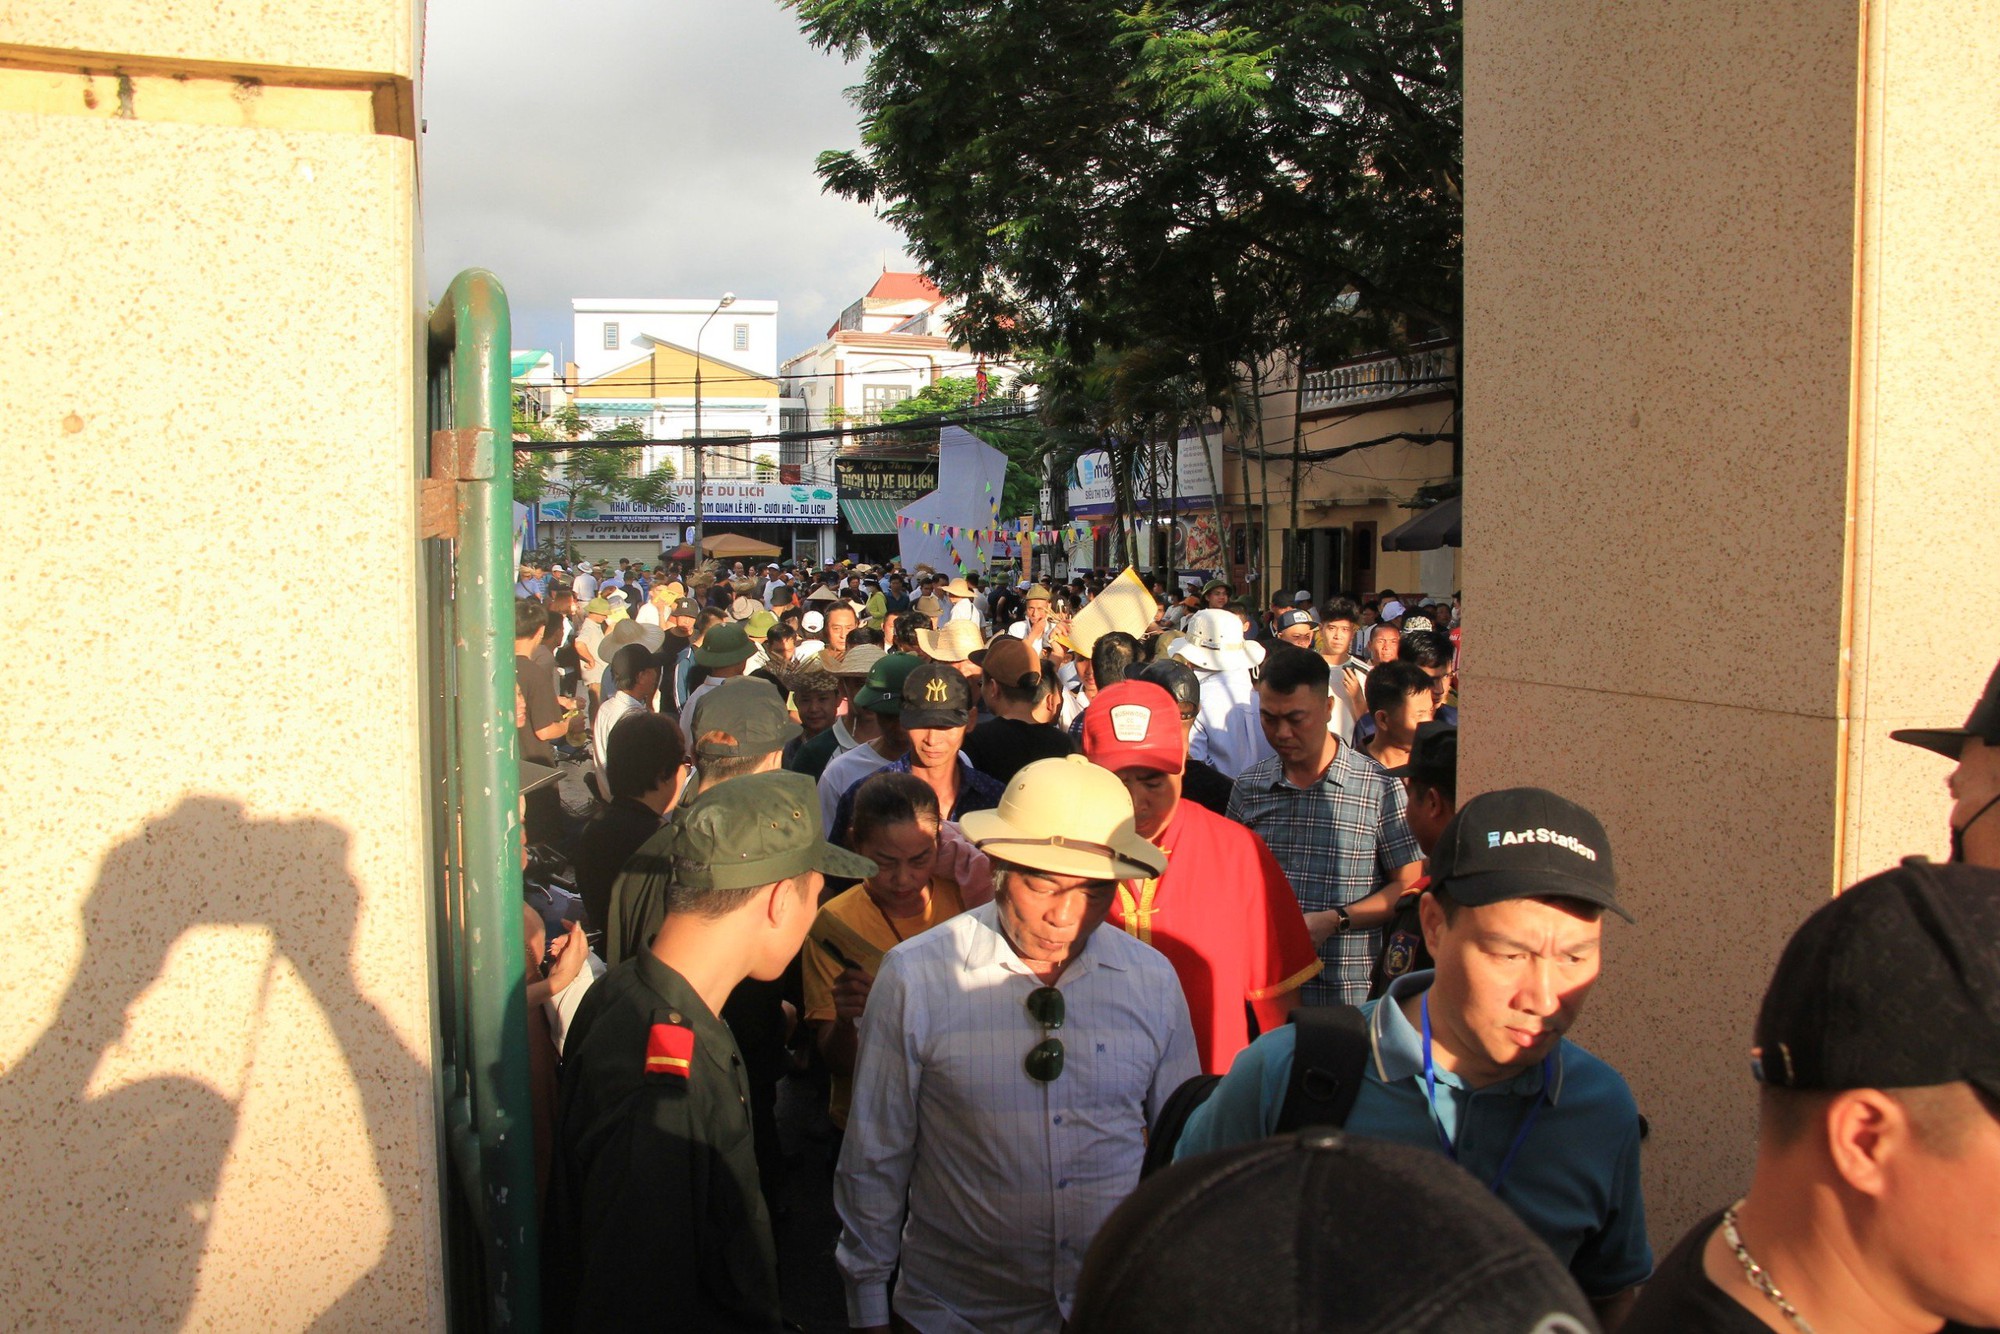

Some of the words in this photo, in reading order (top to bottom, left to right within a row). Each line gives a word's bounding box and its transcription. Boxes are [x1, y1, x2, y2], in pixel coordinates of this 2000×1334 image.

[842, 473, 864, 490] DỊCH
[867, 473, 880, 490] VỤ
[882, 473, 895, 488] XE
[897, 474, 911, 488] DU
[913, 474, 934, 490] LỊCH
[718, 486, 735, 496] DU
[739, 486, 765, 499] LỊCH
[715, 503, 734, 514] QUAN
[800, 504, 810, 514] DU
[589, 523, 617, 533] Tom
[621, 523, 651, 533] Nail
[1502, 827, 1597, 862] ArtStation
